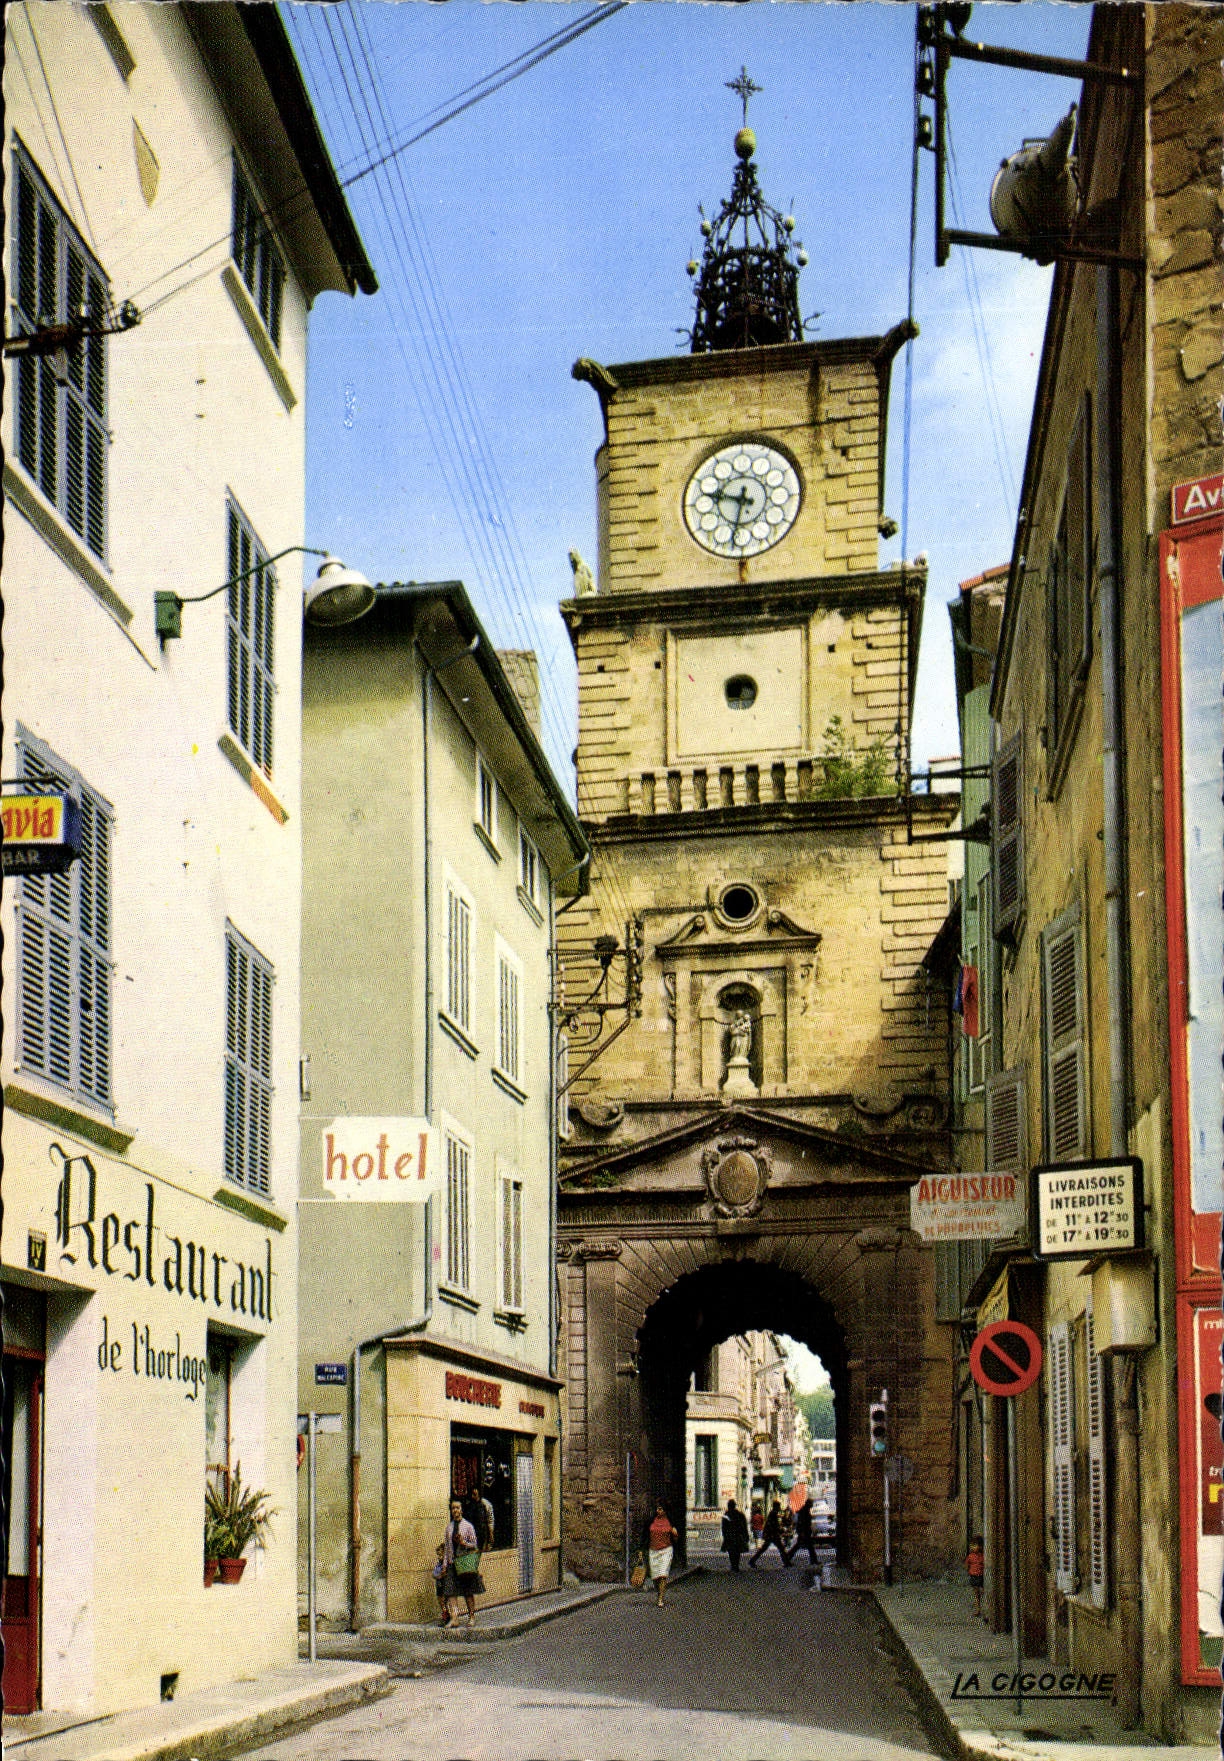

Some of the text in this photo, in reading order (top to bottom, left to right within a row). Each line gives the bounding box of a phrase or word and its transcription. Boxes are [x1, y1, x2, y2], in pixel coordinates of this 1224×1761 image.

[325, 1133, 428, 1181] hotel
[917, 1175, 1016, 1203] AIGUISEUR
[1049, 1175, 1125, 1193] LIVRAISONS
[1050, 1192, 1124, 1210] INTERDITES
[49, 1142, 278, 1322] Restaurant
[1046, 1218, 1057, 1228] DE
[1046, 1234, 1057, 1244] DE
[97, 1316, 206, 1402] de l'horloge
